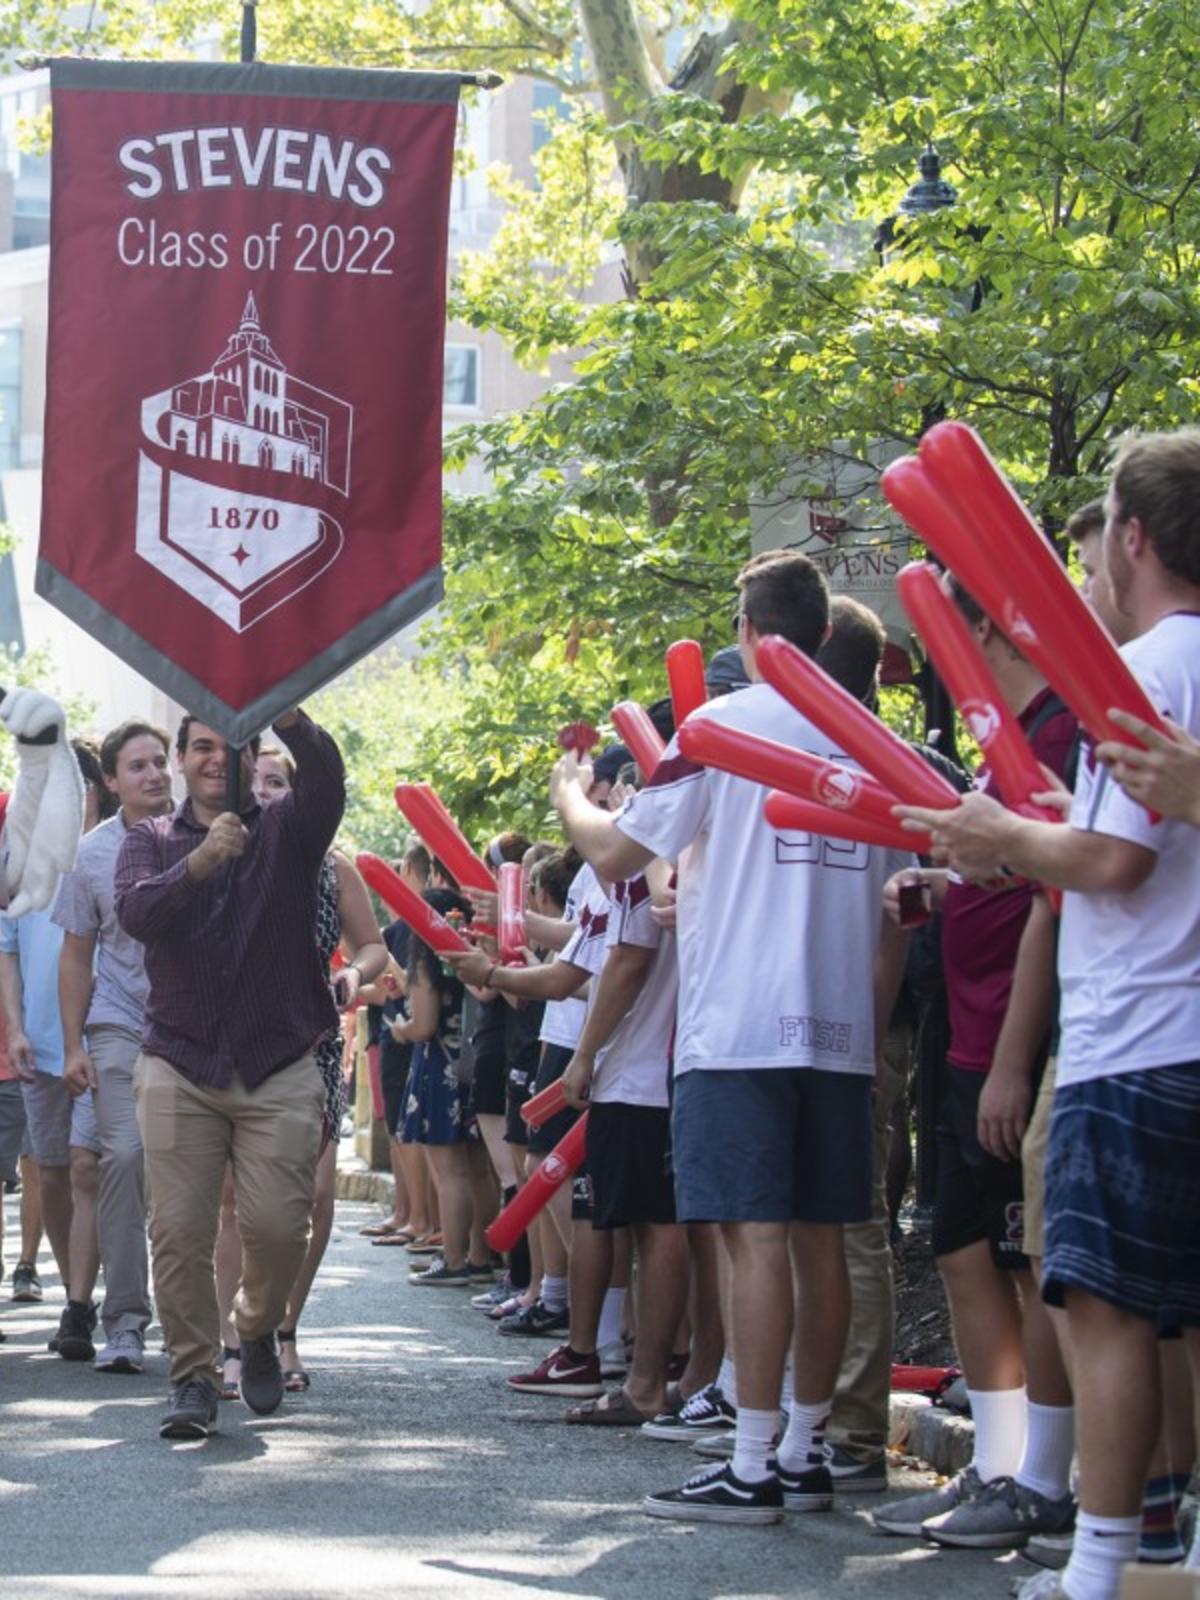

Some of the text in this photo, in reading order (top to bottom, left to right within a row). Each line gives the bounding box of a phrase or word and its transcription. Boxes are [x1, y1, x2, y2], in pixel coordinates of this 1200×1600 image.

[119, 127, 392, 208] STEVENS
[118, 217, 396, 275] Class of 2022
[207, 506, 280, 531] 1870
[816, 553, 900, 576] VENS
[779, 1015, 853, 1053] FISH
